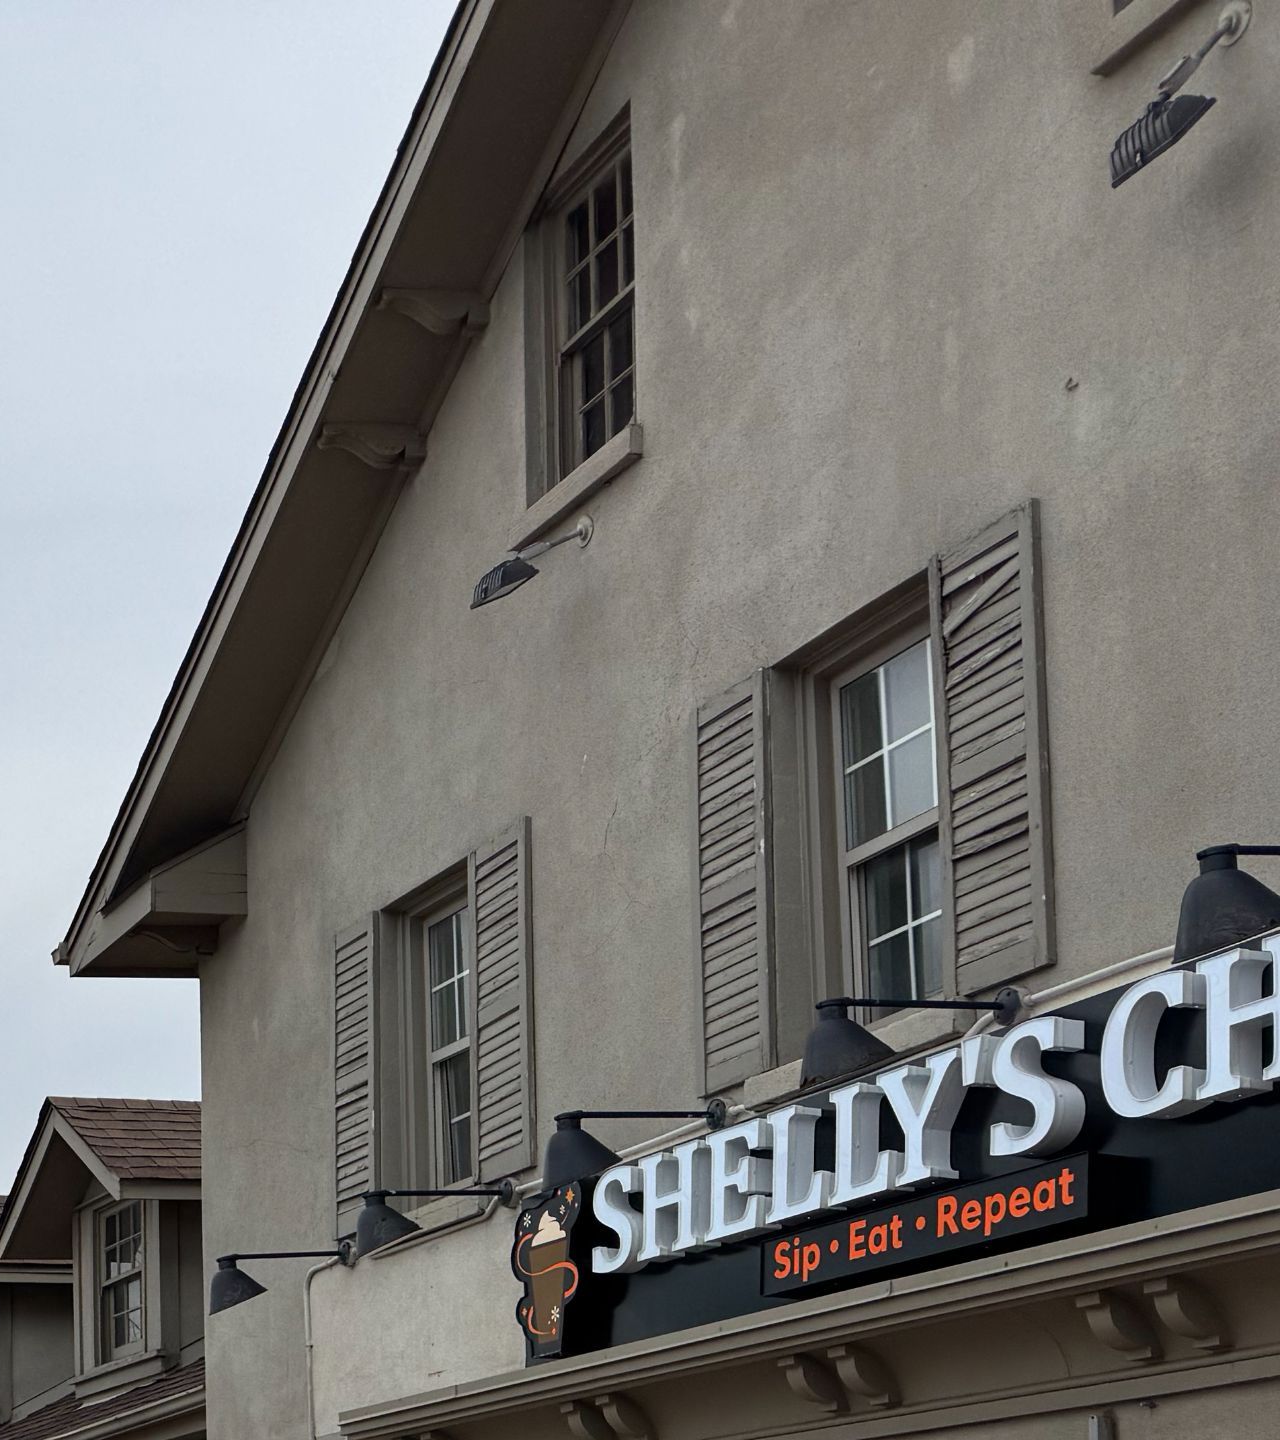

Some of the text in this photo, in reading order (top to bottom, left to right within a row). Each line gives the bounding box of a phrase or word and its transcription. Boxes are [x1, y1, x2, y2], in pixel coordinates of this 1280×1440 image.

[592, 1014, 1086, 1274] SHELLY'S
[773, 1167, 1075, 1283] Sip Eat Repeat
